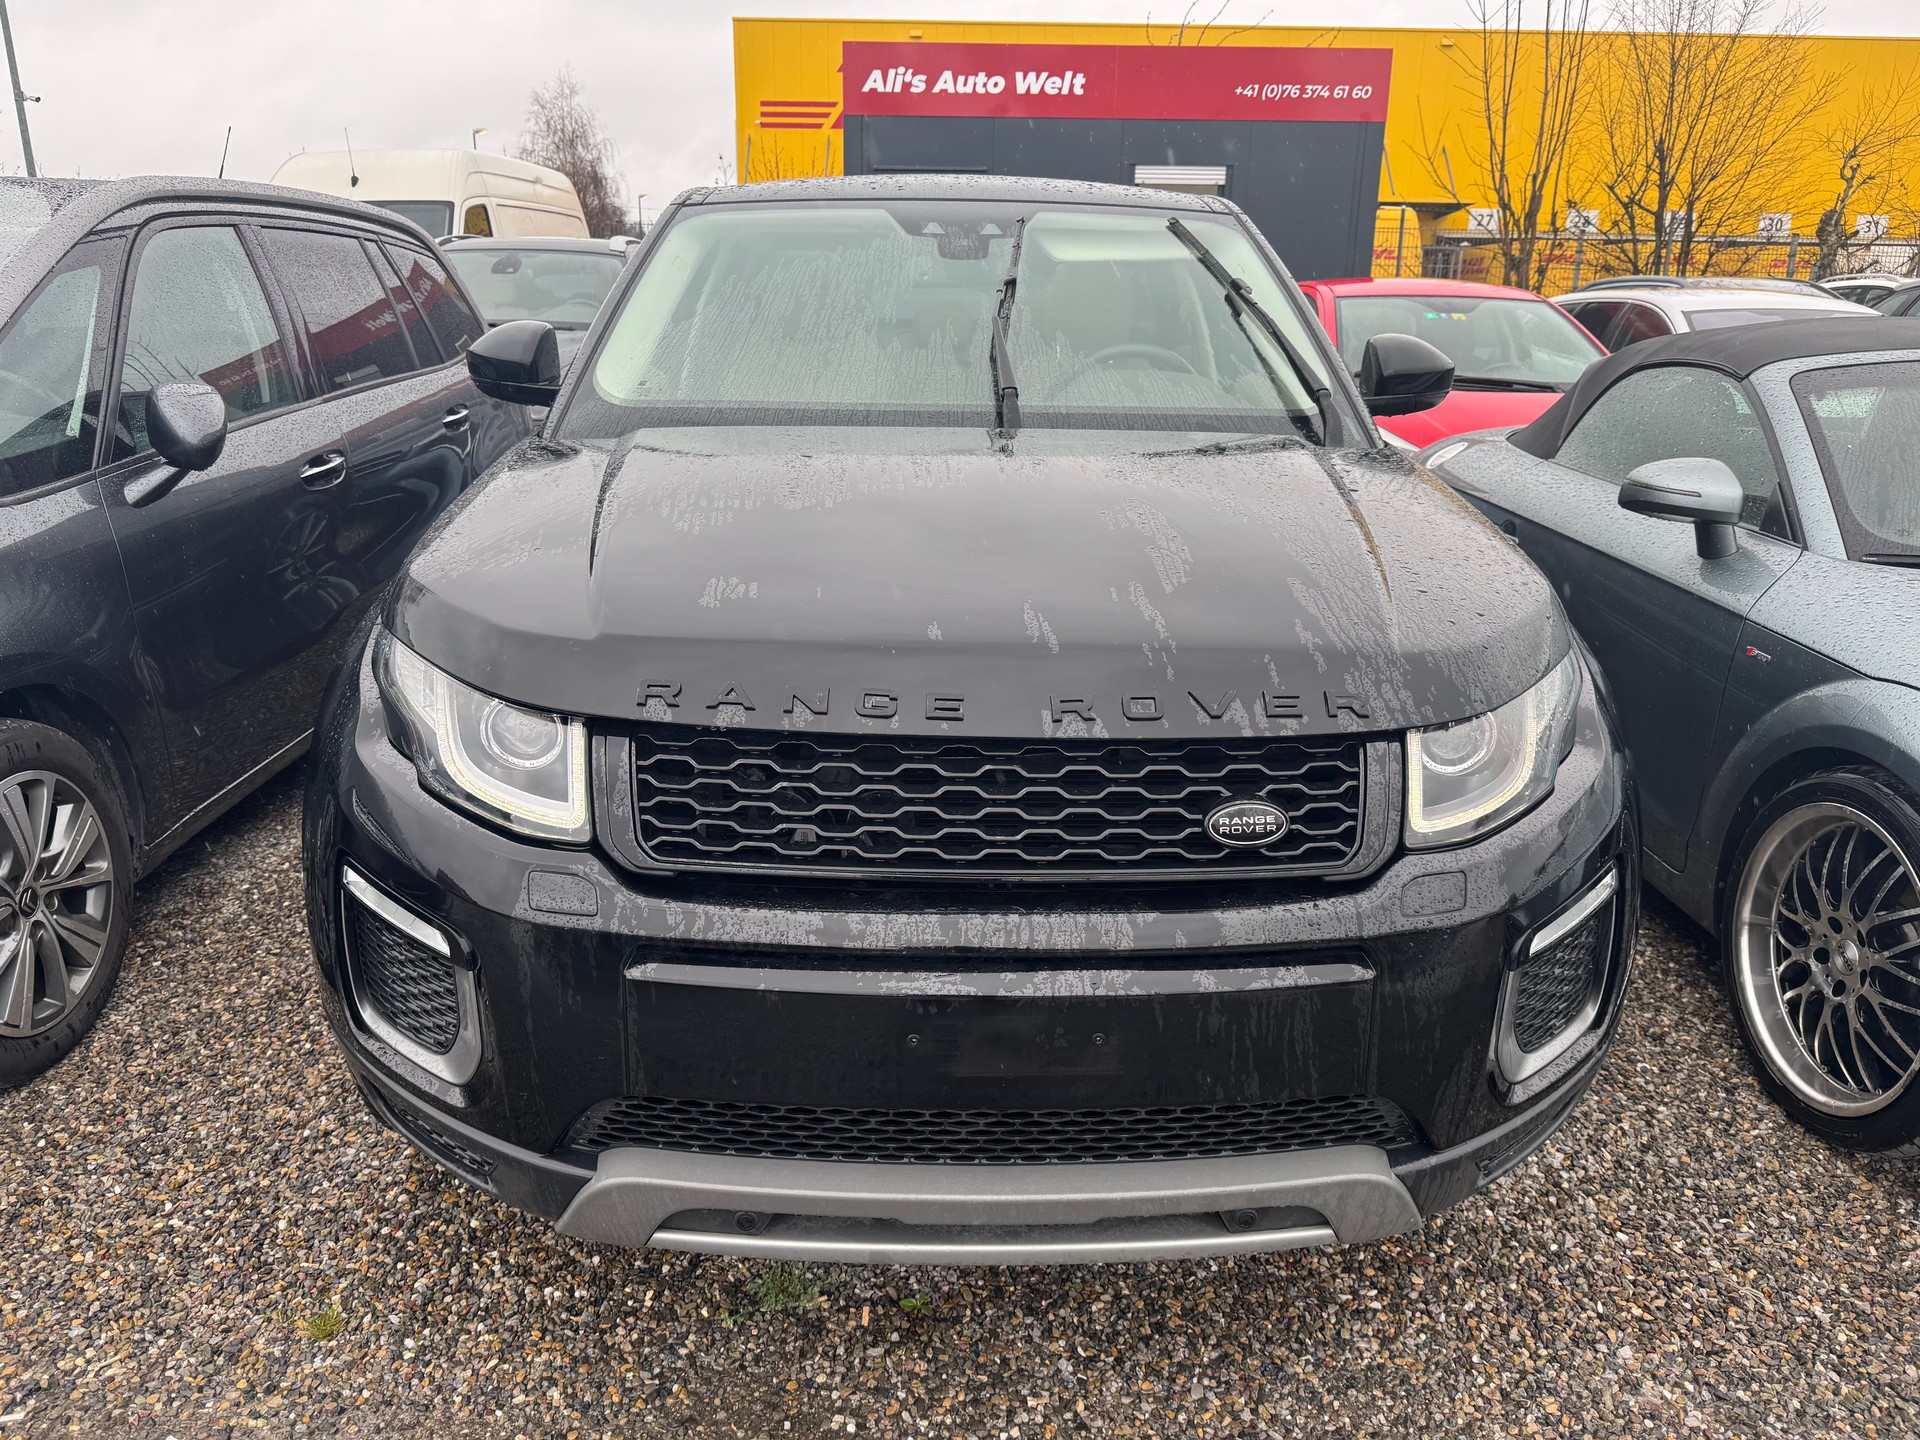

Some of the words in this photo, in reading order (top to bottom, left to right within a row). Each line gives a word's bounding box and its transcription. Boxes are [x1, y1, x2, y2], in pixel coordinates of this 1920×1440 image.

[931, 70, 1006, 95] Auto
[1015, 71, 1086, 95] Welt
[1234, 84, 1259, 97] +41
[1261, 84, 1301, 101] (0)76
[1302, 85, 1330, 98] 374
[1333, 86, 1350, 98] 61
[1351, 86, 1372, 99] 60
[1476, 213, 1494, 227] 27
[1765, 217, 1783, 232] 30
[636, 679, 965, 721] RANGE
[1049, 690, 1370, 722] ROVER
[1219, 815, 1276, 825] RANGE
[1219, 824, 1277, 834] ROVER
